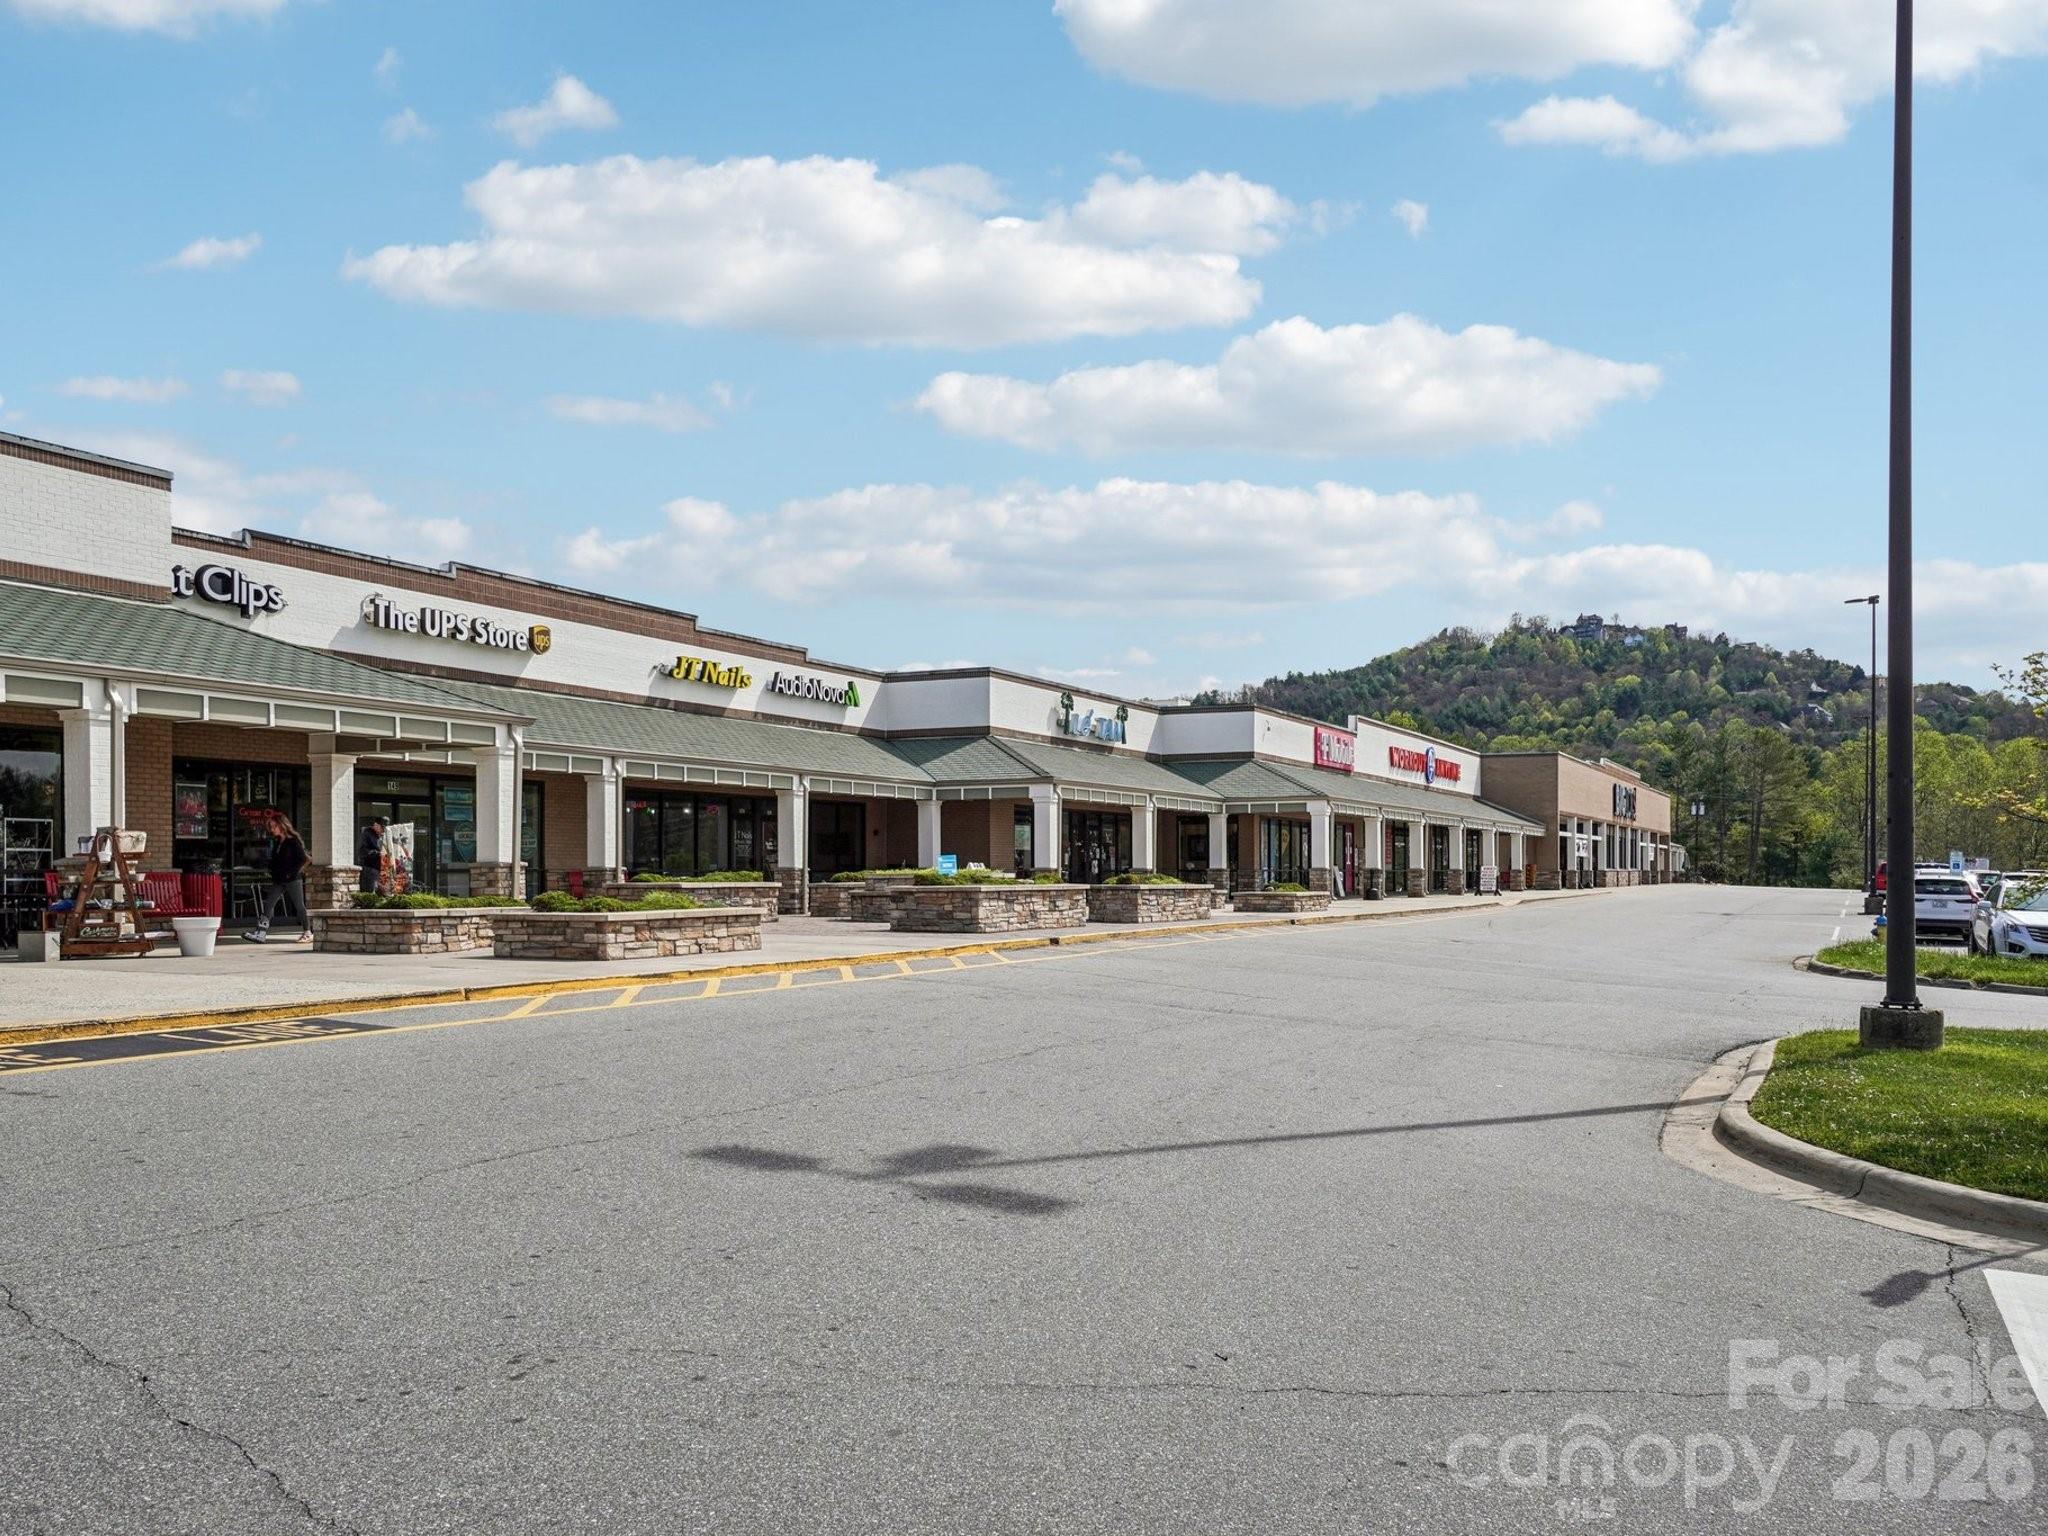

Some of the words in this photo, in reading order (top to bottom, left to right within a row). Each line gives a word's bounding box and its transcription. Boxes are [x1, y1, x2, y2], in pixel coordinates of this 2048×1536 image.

[195, 564, 286, 618] Clips
[374, 598, 419, 634] The
[421, 607, 469, 642] UPS
[472, 616, 529, 651] Store
[534, 632, 550, 649] ups
[673, 655, 700, 682] JT
[702, 660, 753, 689] Nails
[771, 671, 847, 705] AudioNova
[1390, 746, 1427, 774] WORKOUT
